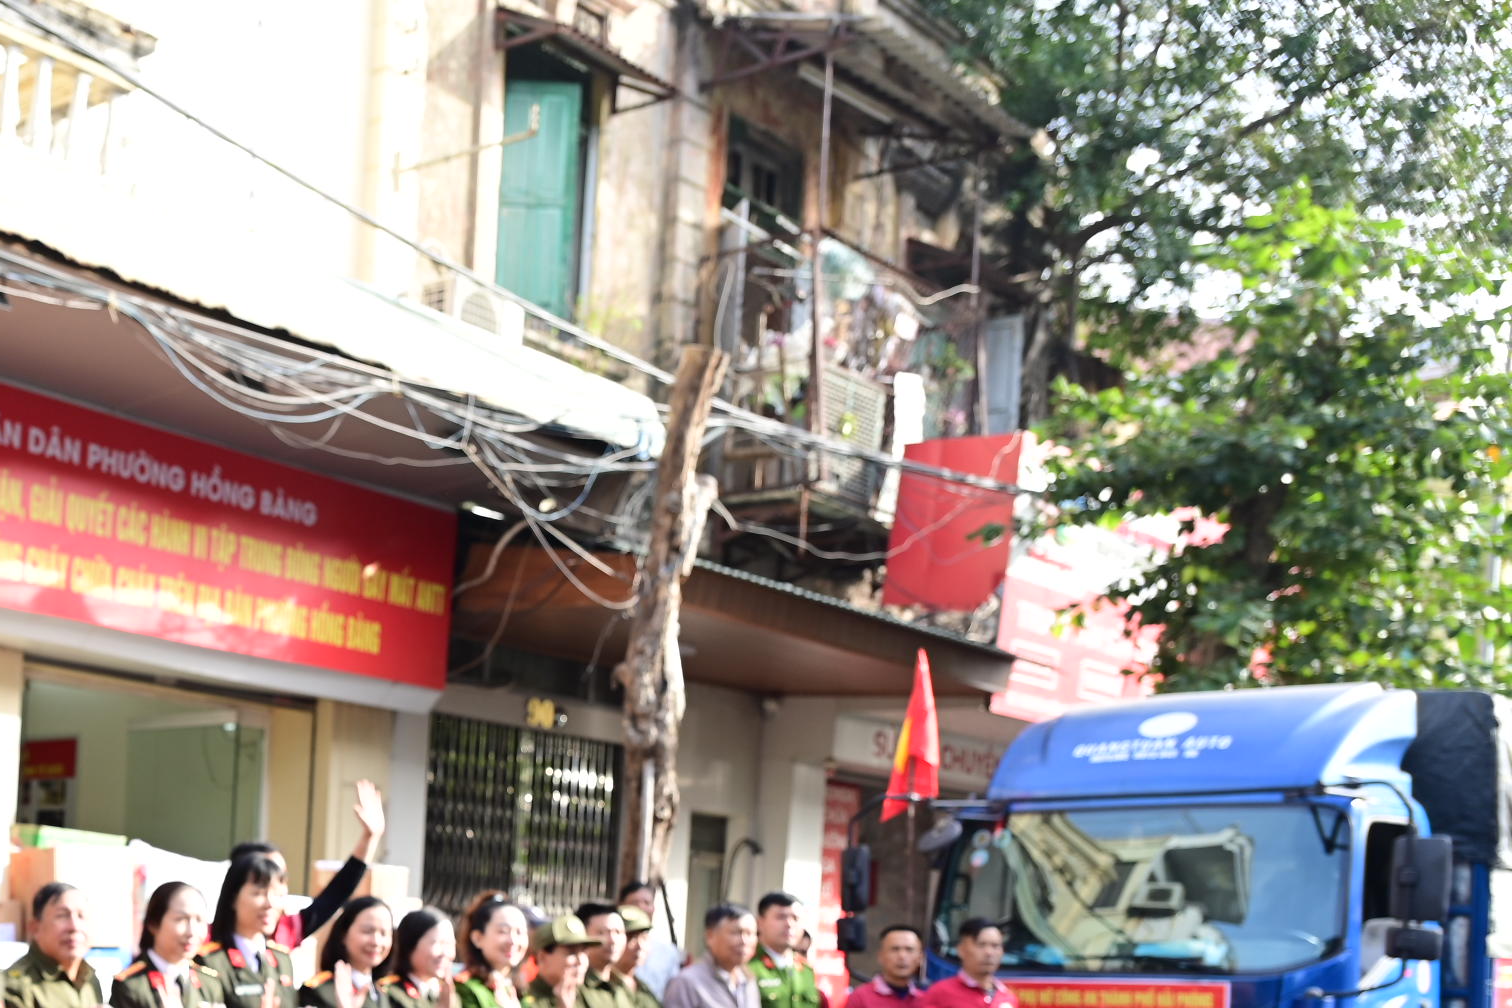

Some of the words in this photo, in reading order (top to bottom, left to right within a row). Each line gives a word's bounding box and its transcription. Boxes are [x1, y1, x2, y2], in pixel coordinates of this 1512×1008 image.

[27, 425, 82, 466] DÂN
[87, 442, 186, 493] PHƯỜNG
[190, 464, 256, 512] HỒNG
[260, 487, 318, 527] BÀNG
[116, 502, 150, 547] CÁC
